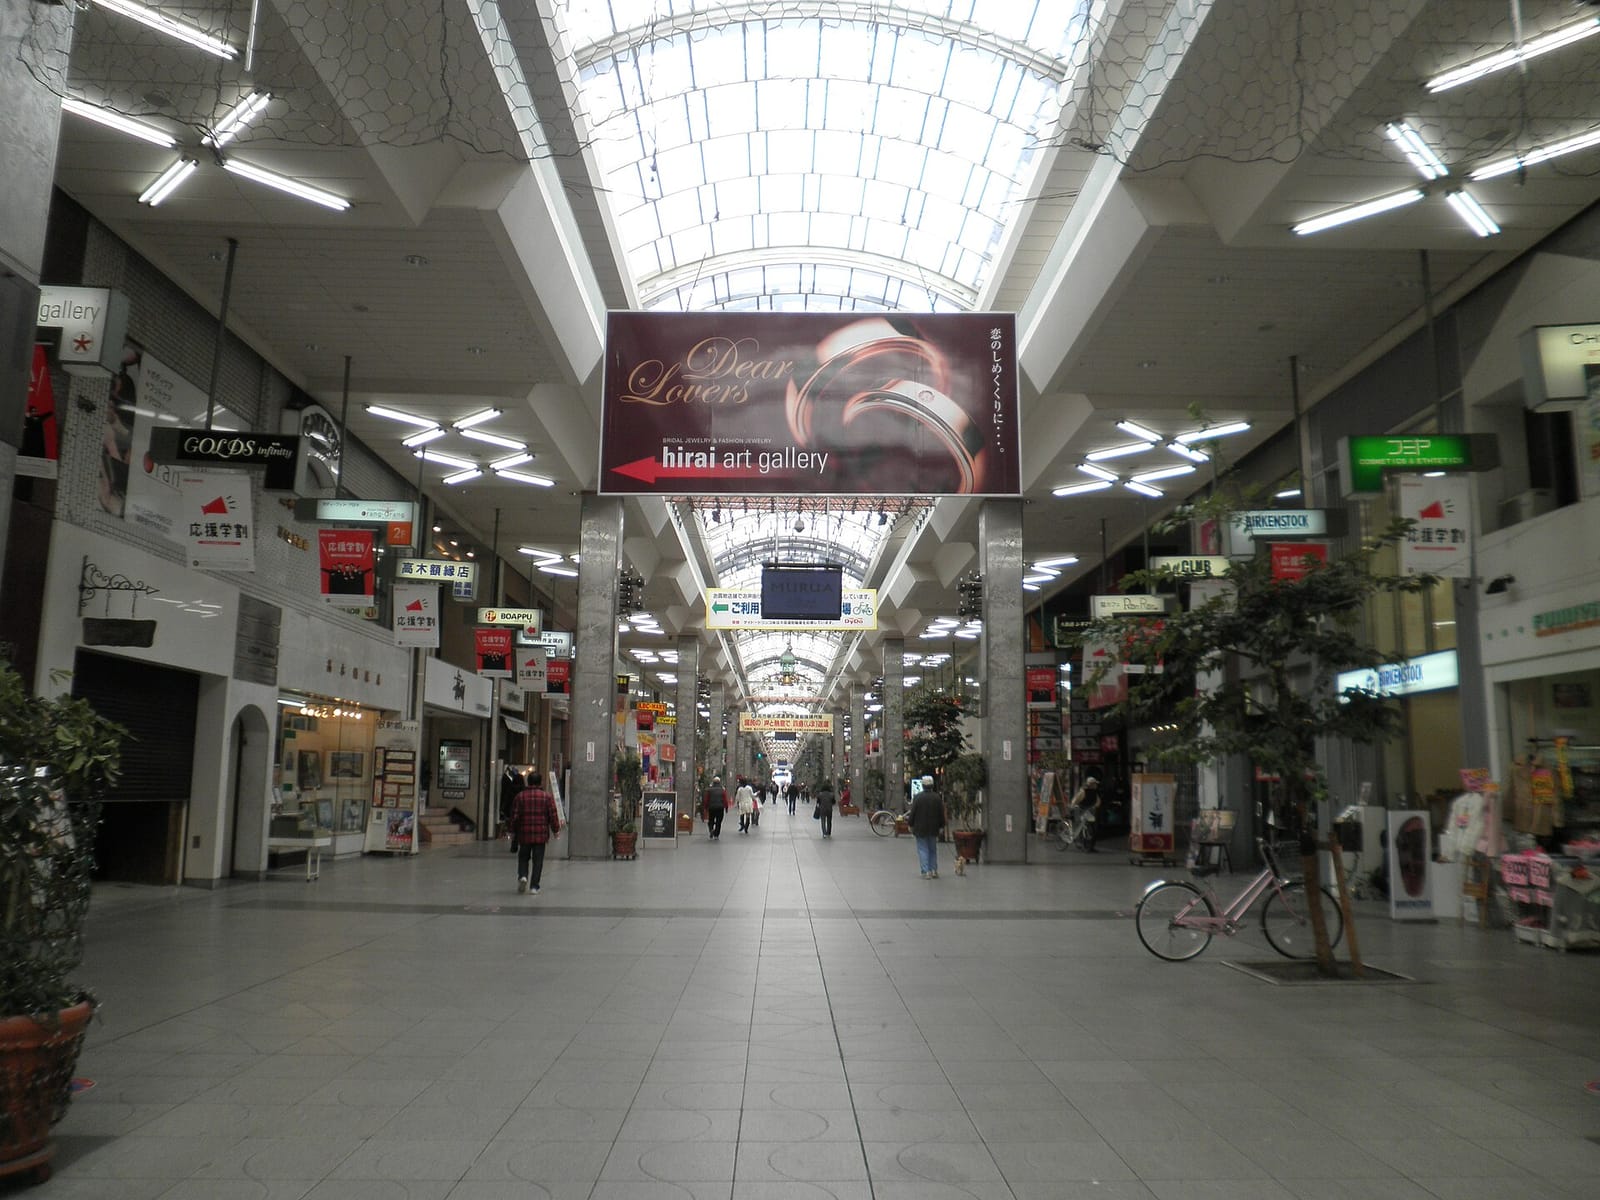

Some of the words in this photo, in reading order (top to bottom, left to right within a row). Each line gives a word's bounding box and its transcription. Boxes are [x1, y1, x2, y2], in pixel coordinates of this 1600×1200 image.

[40, 300, 99, 324] gallery
[681, 337, 793, 379] Dear
[184, 436, 256, 458] GOLDS
[257, 445, 292, 459] infinity
[662, 446, 716, 469] hirai
[723, 449, 752, 469] art
[758, 446, 829, 474] gallery
[1246, 515, 1309, 528] BIRKENSTOCK
[189, 522, 248, 539] 応援学割
[393, 527, 406, 539] 2F
[1405, 527, 1466, 544] 応援学割
[328, 541, 365, 553] 応援学割
[401, 562, 470, 578] 高木額縁店
[770, 583, 833, 593] MURUA
[396, 616, 436, 627] 応援学割
